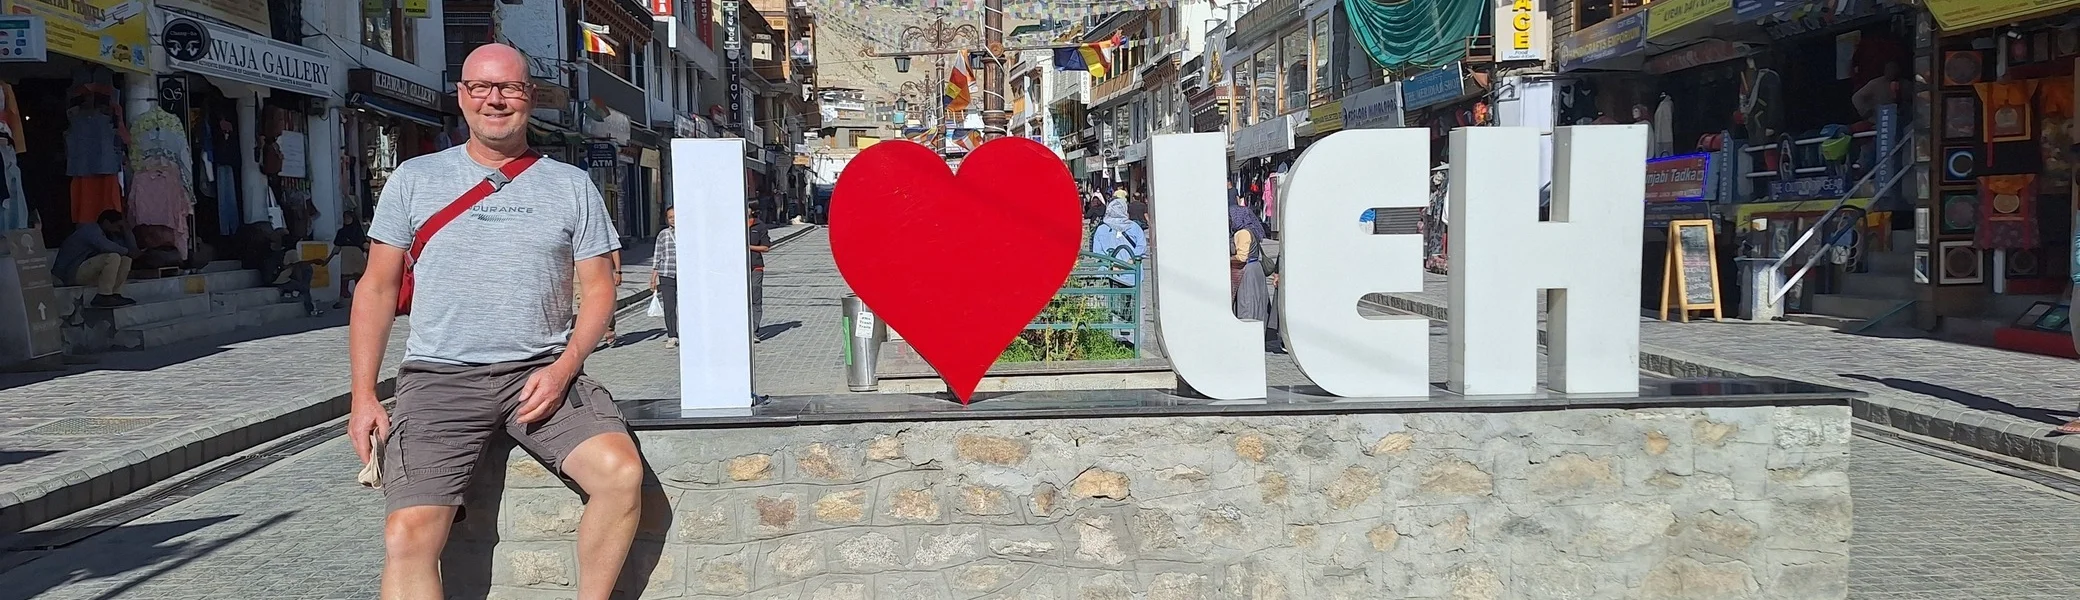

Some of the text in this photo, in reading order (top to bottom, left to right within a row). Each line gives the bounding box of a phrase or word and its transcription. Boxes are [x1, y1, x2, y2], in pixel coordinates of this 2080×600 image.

[203, 39, 330, 85] WAJA GALLERY
[375, 71, 408, 95] KHAWAJA
[409, 83, 436, 105] GALLERY
[729, 61, 739, 120] Travel
[592, 159, 613, 167] ATM
[1671, 168, 1696, 182] Tadka
[671, 138, 753, 410] I
[1149, 124, 1647, 399] LEH
